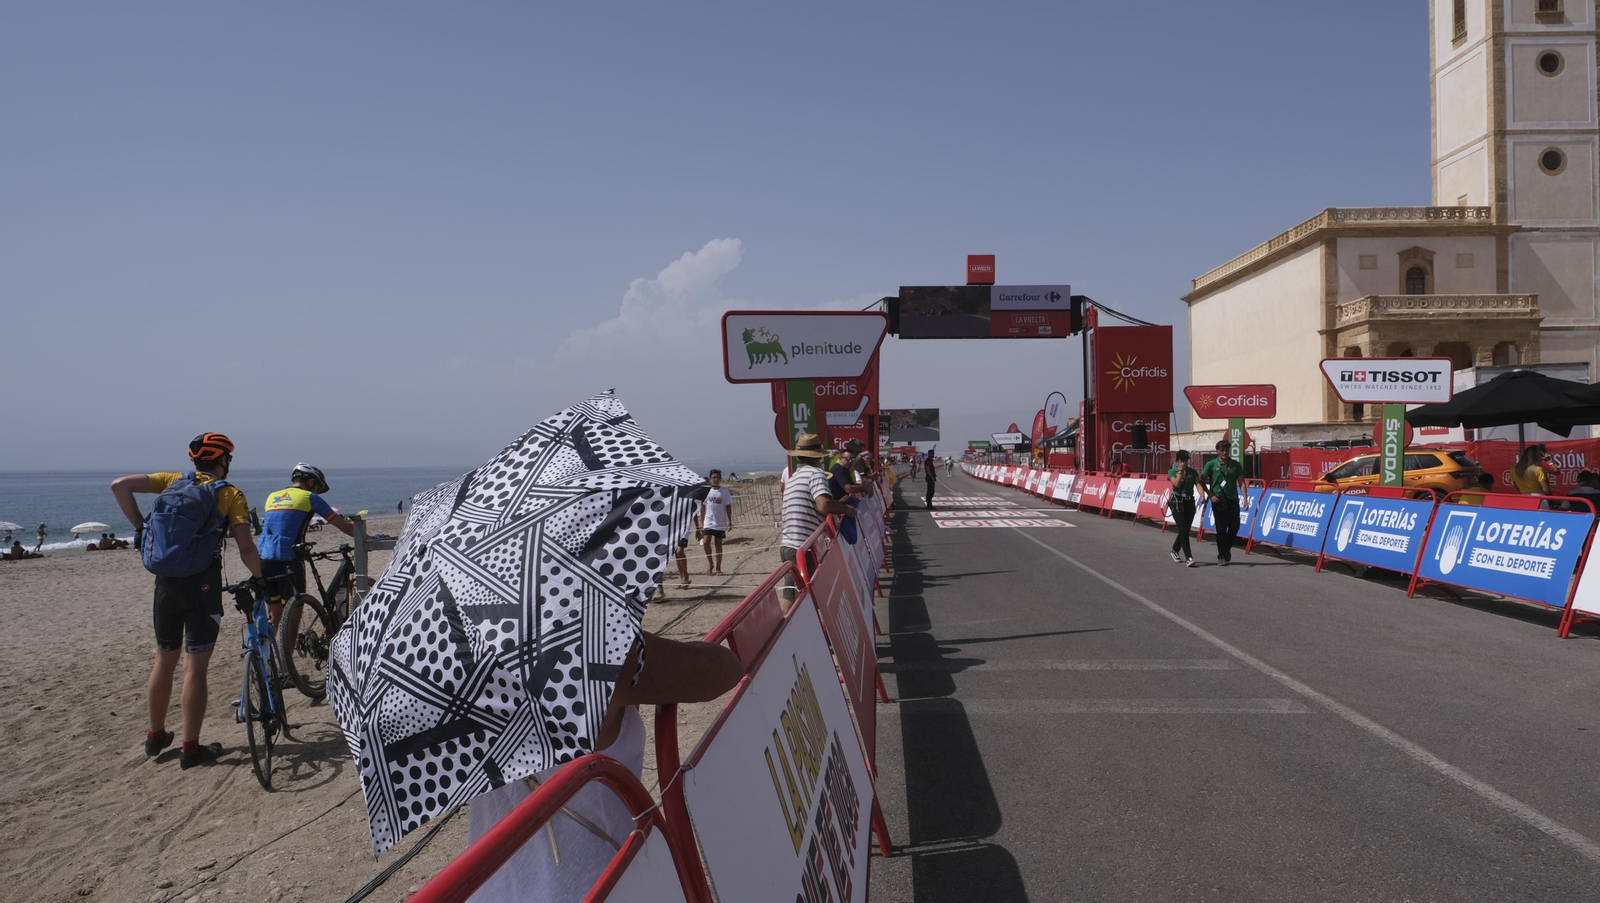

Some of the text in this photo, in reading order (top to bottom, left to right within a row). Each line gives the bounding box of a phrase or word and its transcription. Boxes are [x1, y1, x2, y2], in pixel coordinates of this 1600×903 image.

[999, 293, 1041, 301] Carrefour
[791, 342, 862, 358] plenitude
[1121, 367, 1167, 377] Cofidis
[1369, 371, 1441, 382] TISSOT
[813, 381, 858, 396] ofidis
[1216, 395, 1268, 406] Cofidis
[1112, 420, 1166, 432] Codis
[1231, 428, 1241, 462] ŠKO
[1385, 418, 1400, 483] ŠKODA
[1282, 499, 1325, 518] LOTERÍAS
[1361, 507, 1418, 530] LOTERÍAS
[1280, 521, 1316, 533] CON EL DEPORTE
[1360, 533, 1405, 549] CON EL DEPORTE
[1475, 521, 1567, 551] LOTERÍAS
[1475, 552, 1548, 573] CON EL DEPORTE
[764, 652, 828, 858] LA PASIÓN
